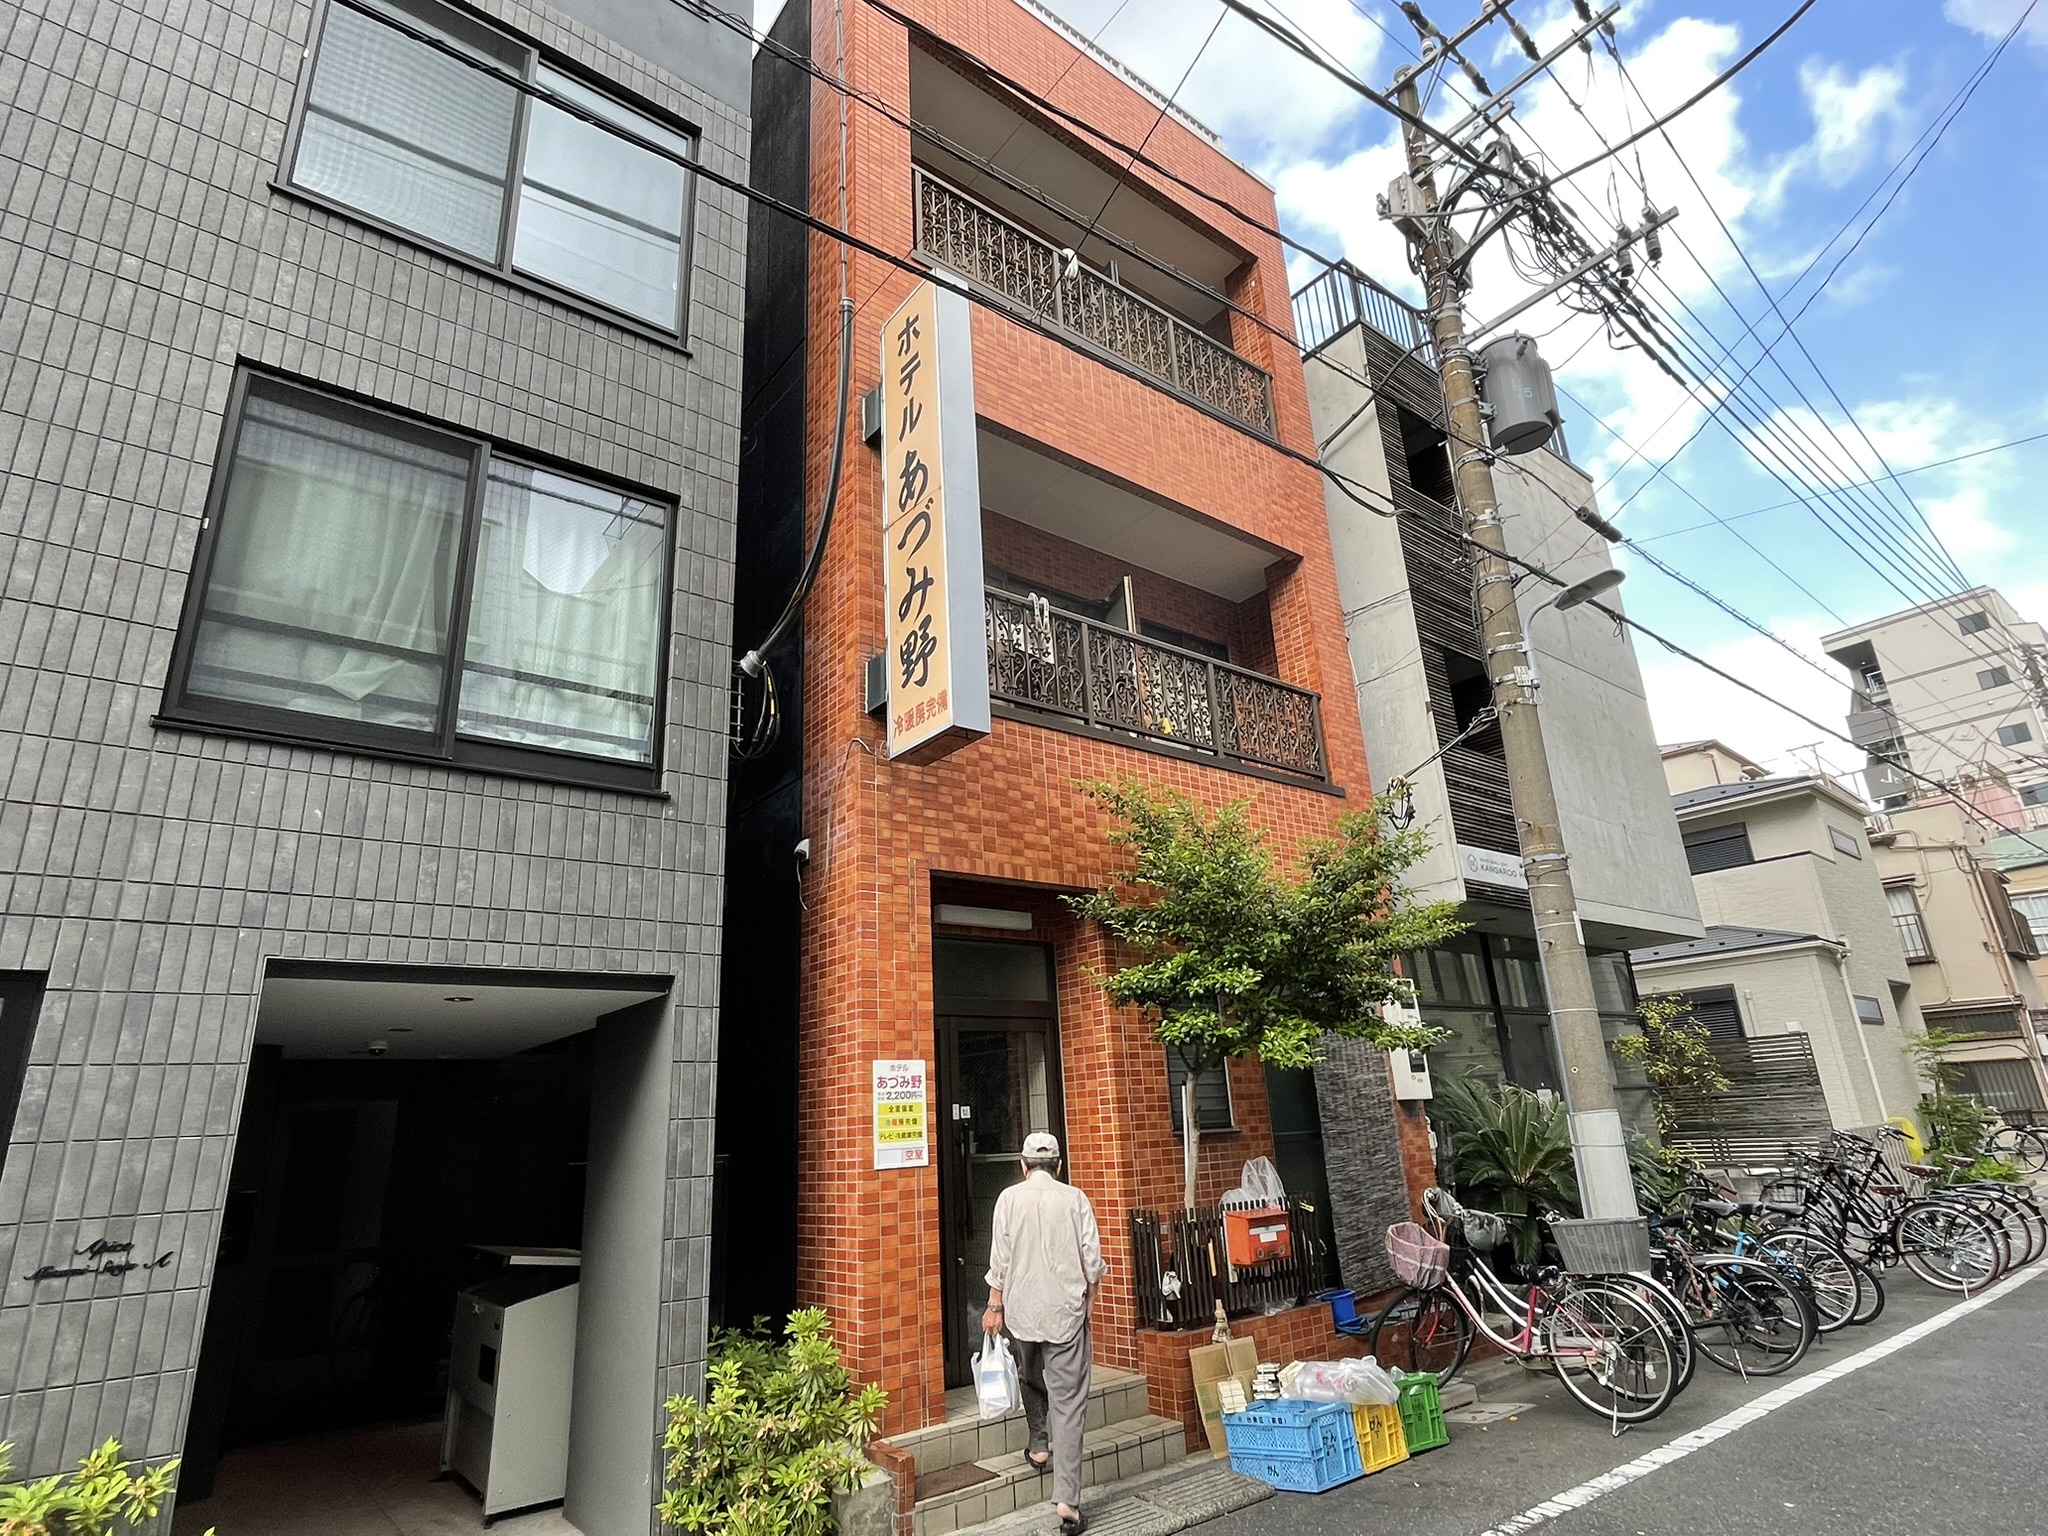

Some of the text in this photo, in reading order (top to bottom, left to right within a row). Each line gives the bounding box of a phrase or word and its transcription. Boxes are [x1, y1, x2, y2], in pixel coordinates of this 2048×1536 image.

[893, 689, 948, 738] 冷暖房完備
[1480, 864, 1517, 877] KANGAROO
[890, 1064, 909, 1072] ホテル
[877, 1075, 922, 1089] あづみ野
